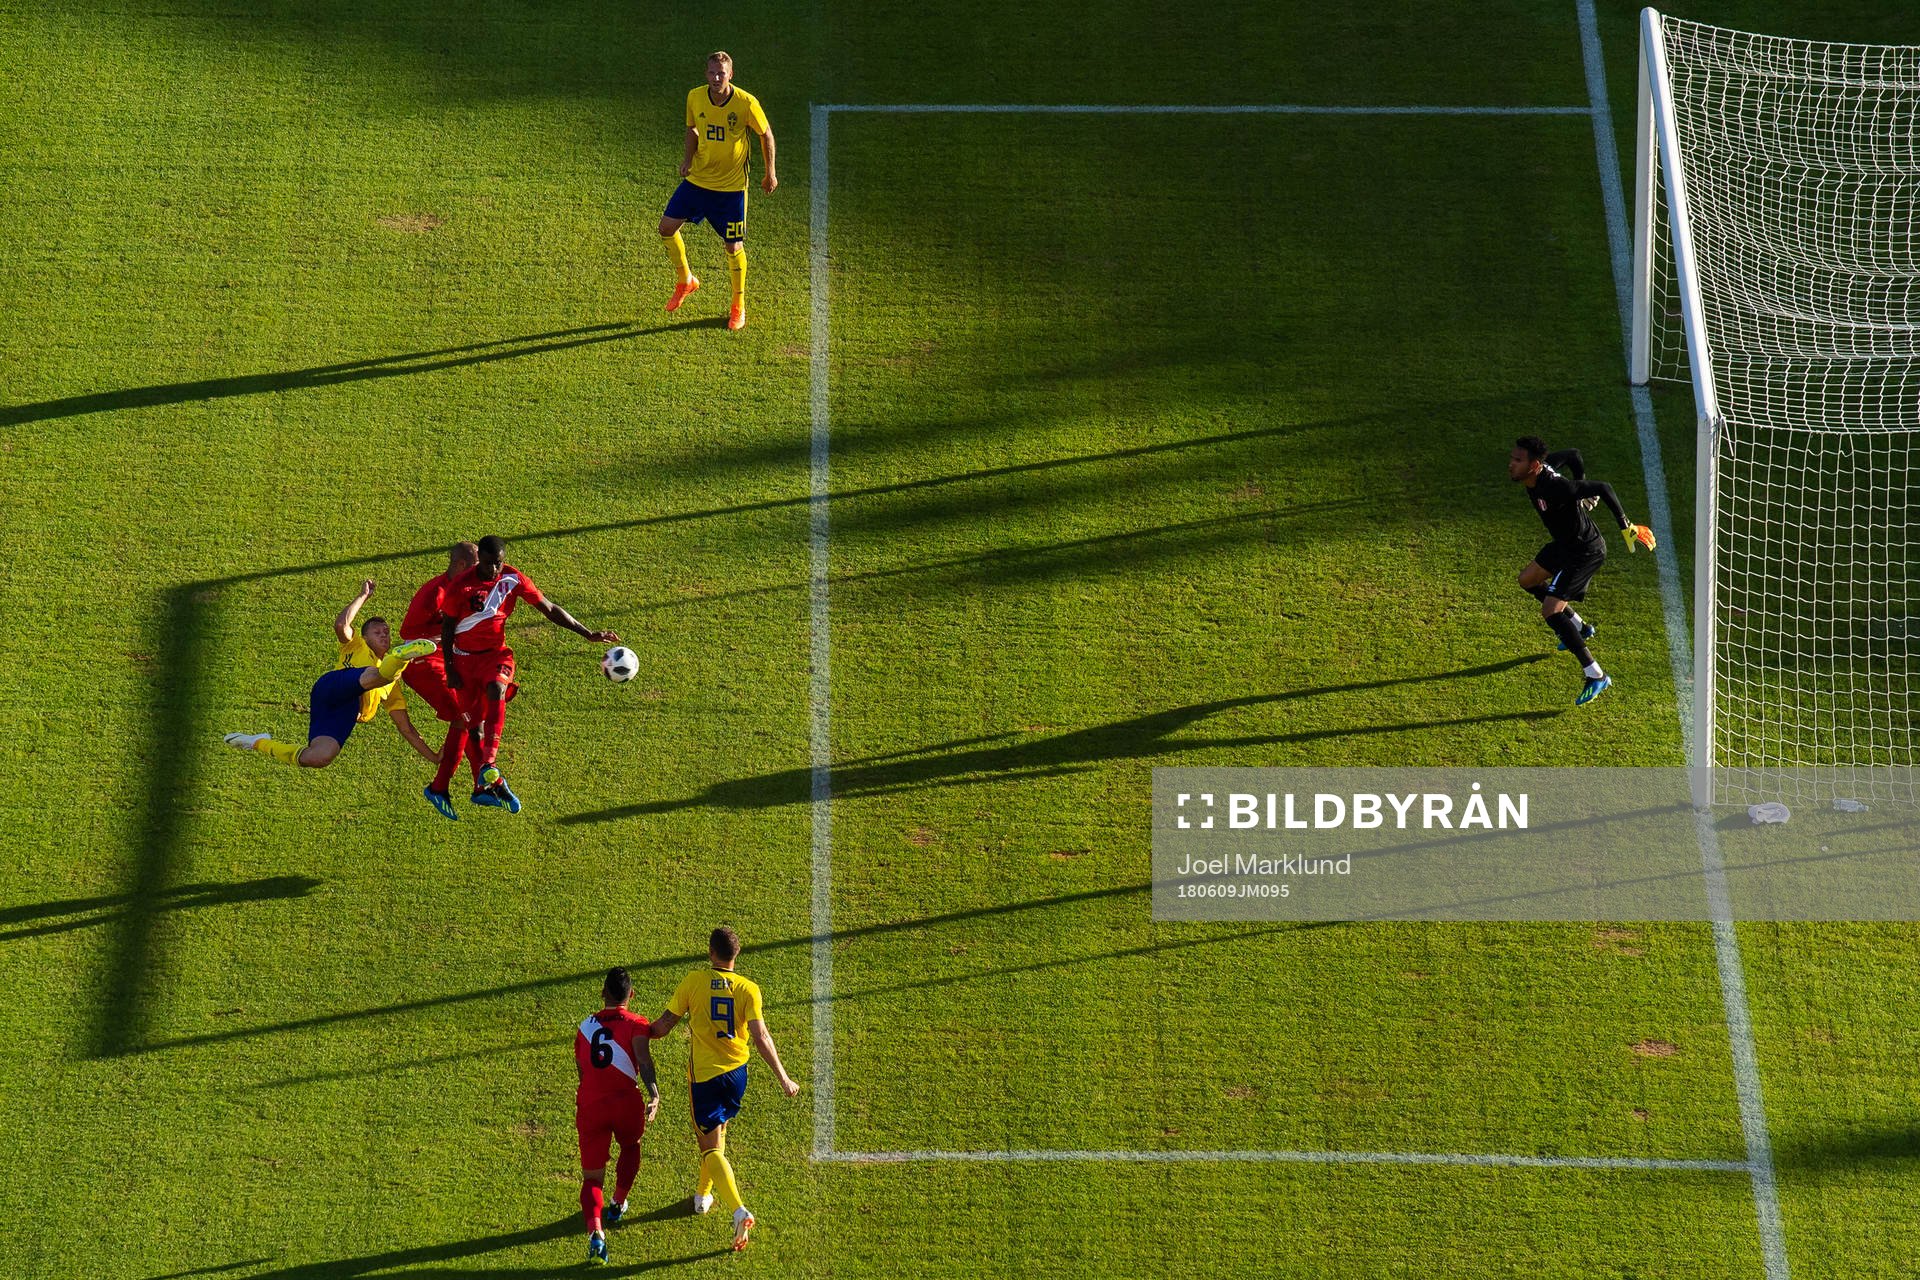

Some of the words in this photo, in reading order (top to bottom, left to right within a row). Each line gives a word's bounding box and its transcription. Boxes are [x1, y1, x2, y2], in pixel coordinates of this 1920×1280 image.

[706, 124, 725, 141] 20
[726, 221, 744, 238] 20
[711, 996, 735, 1038] 9
[591, 1027, 614, 1068] 6
